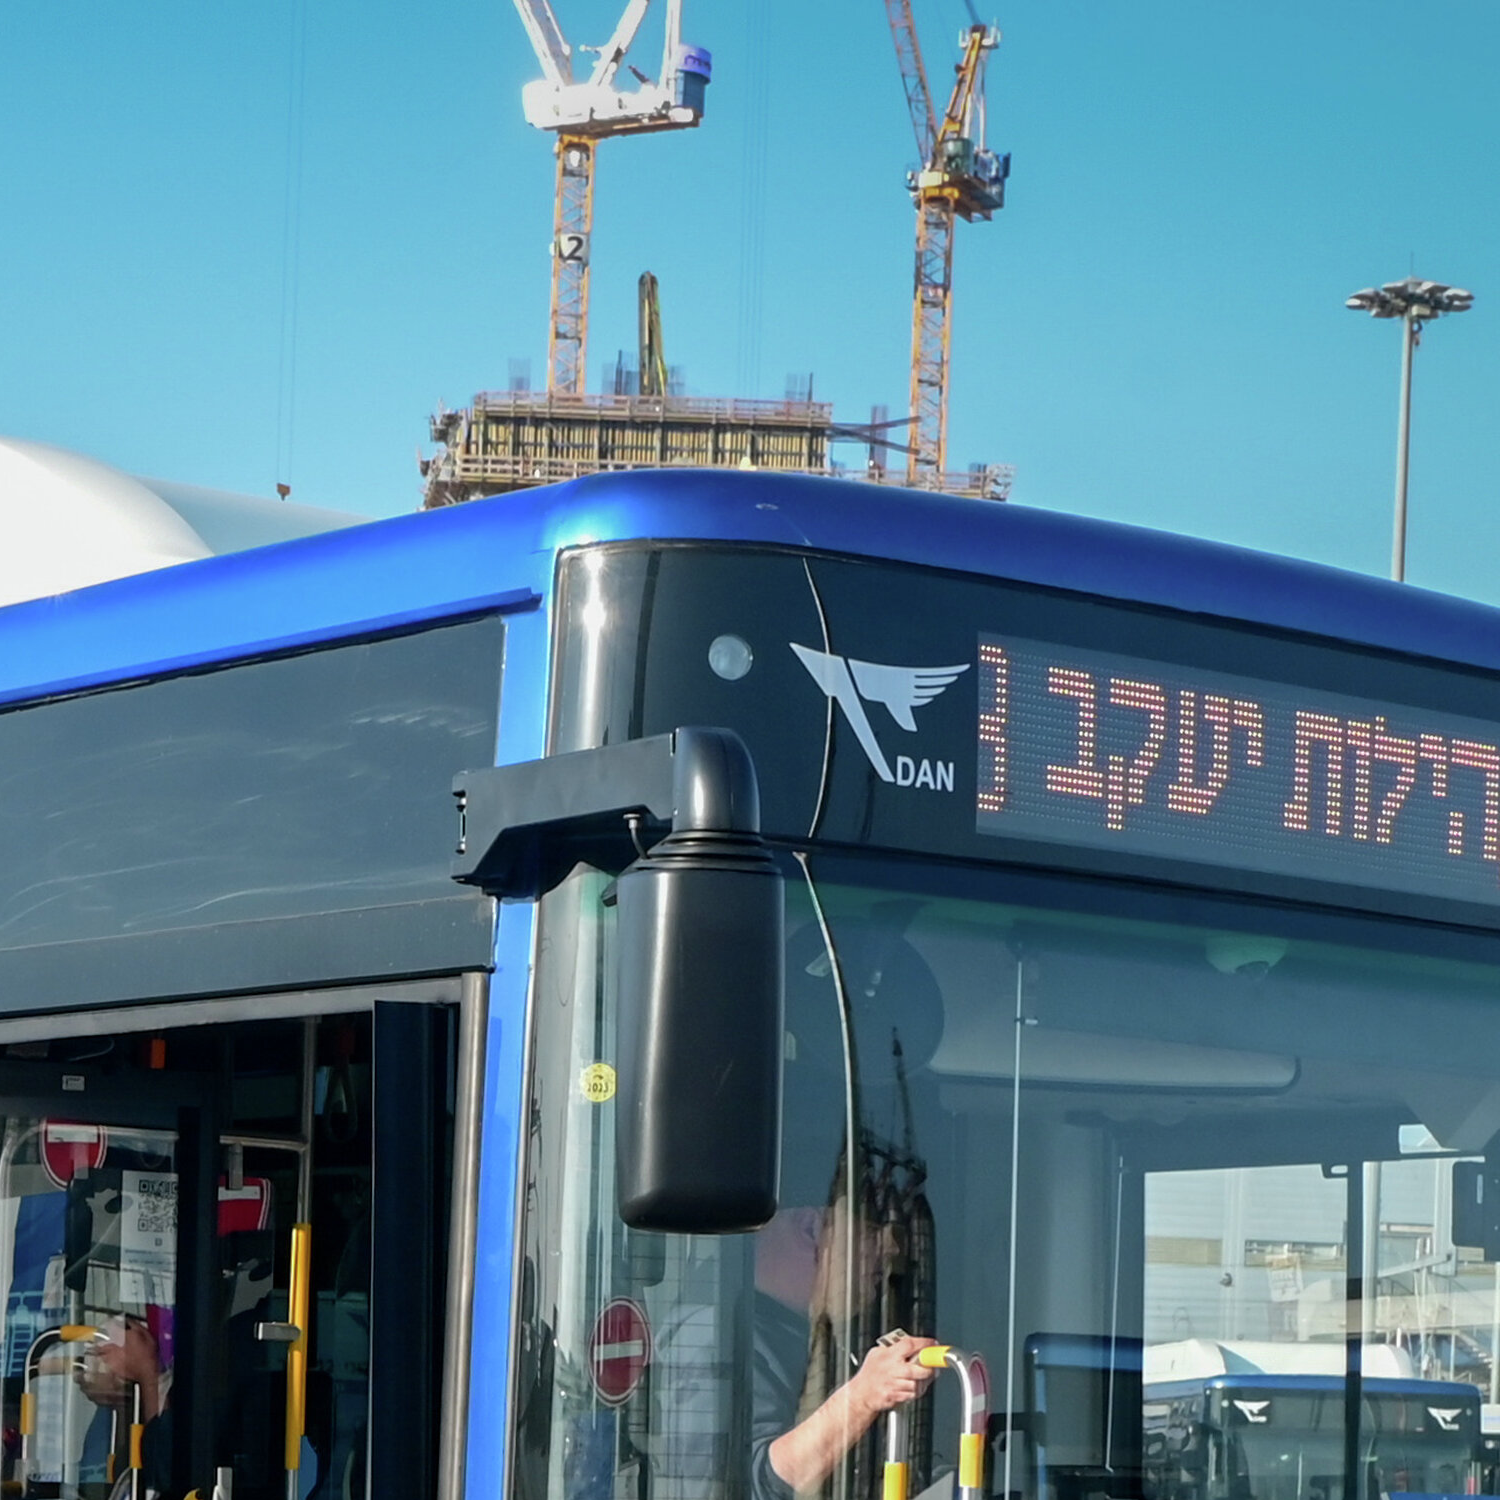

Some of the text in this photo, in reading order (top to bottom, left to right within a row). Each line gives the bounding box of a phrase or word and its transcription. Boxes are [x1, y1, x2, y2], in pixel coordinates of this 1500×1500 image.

[896, 755, 954, 792] DAN
[1045, 667, 1265, 830] יעקב
[1284, 711, 1500, 866] הילות
